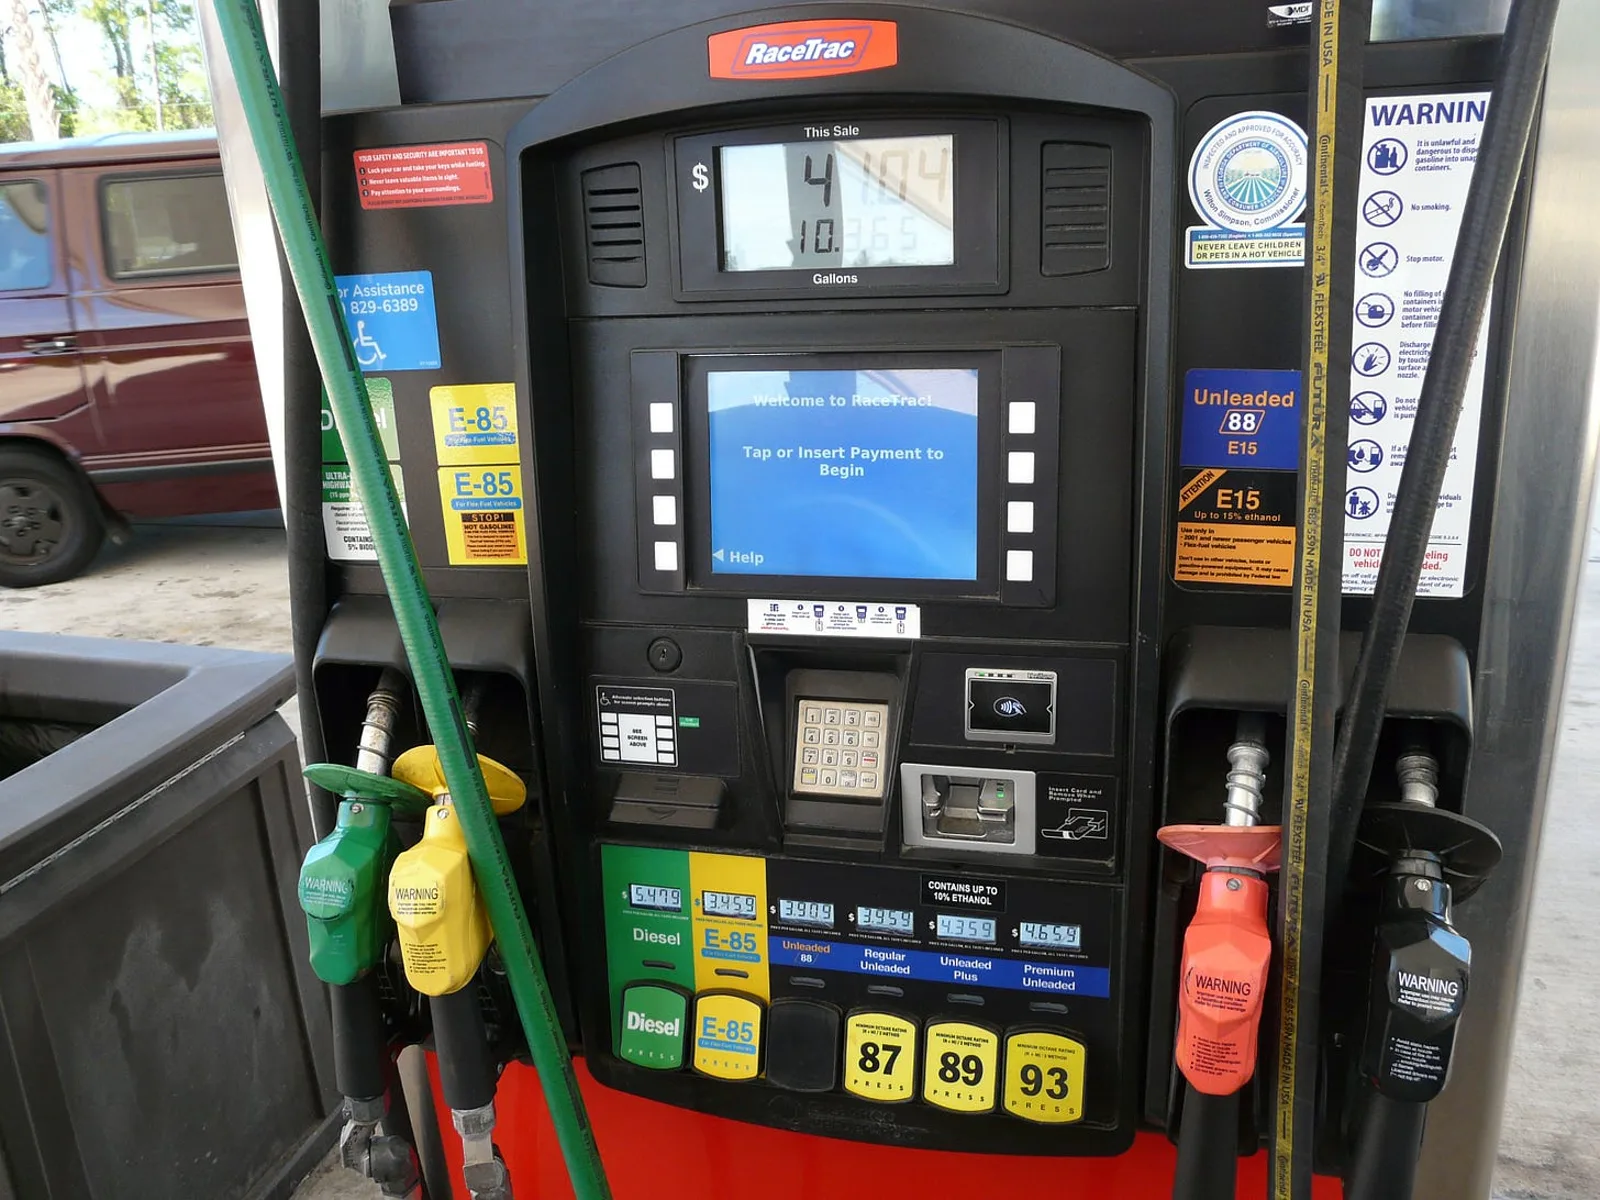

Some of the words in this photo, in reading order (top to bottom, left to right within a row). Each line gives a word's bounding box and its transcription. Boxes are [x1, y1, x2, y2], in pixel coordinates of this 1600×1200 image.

[1324, 22, 1333, 36] IN
[745, 39, 855, 65] RaceTrac
[1323, 40, 1333, 67] USA
[1371, 100, 1487, 127] WARNIN
[804, 127, 830, 138] This
[833, 126, 860, 137] Sale
[1237, 124, 1272, 135] APPROVED
[1272, 127, 1285, 138] FOR
[1431, 138, 1461, 146] unlawful
[372, 153, 392, 161] SAFETY
[403, 151, 427, 160] SECURITY
[428, 150, 438, 158] ARE
[439, 149, 468, 157] IMPORTANT
[1416, 148, 1452, 156] dangerous
[1318, 134, 1331, 188] Continental
[1415, 156, 1443, 165] gasoline
[367, 166, 380, 174] Lock
[381, 166, 392, 174] your
[402, 164, 412, 172] and
[692, 163, 709, 192] $
[371, 189, 380, 197] Pay
[1203, 189, 1218, 213] Wilton
[1254, 187, 1300, 225] Commissioner
[1421, 203, 1451, 212] smoking.
[1197, 242, 1226, 250] NEVER
[1228, 241, 1255, 250] LEAVE
[1258, 241, 1302, 249] CHILDREN
[1210, 251, 1230, 259] PETS
[1268, 250, 1302, 258] VEHICLE
[1406, 255, 1421, 263] Stop
[813, 273, 858, 285] Gallons
[353, 283, 424, 297] Assistance
[1414, 290, 1433, 298] filling
[350, 298, 418, 314] 829-6389
[1313, 292, 1326, 353] FLEXSTEEL
[1400, 341, 1431, 349] Discharge
[753, 395, 824, 408] Welcome
[830, 395, 845, 408] to
[852, 394, 932, 408] RaceTrac!
[1193, 389, 1294, 407] Unleaded
[449, 406, 508, 432] E-85
[1228, 412, 1256, 431] 88
[743, 446, 771, 462] Tap
[777, 448, 793, 459] or
[799, 447, 845, 459] Insert
[851, 447, 921, 463] Payment
[927, 448, 944, 460] to
[1228, 441, 1257, 455] E15
[820, 464, 865, 479] Begin
[454, 472, 514, 496] E-85
[1181, 470, 1215, 502] ATTENTION
[1216, 488, 1260, 510] E15
[472, 513, 504, 522] STOP!
[1194, 511, 1207, 521] Up
[1209, 512, 1219, 520] to
[1223, 512, 1242, 521] 15%
[1245, 513, 1280, 522] ethanol
[729, 552, 764, 566] Help
[1349, 548, 1361, 557] DO
[1363, 548, 1381, 557] NOT
[1304, 558, 1315, 592] MADE
[1304, 592, 1313, 606] IN
[1302, 608, 1313, 633] USA
[829, 715, 835, 723] 2
[305, 877, 348, 894] WARNING
[928, 880, 970, 893] CONTAINS
[972, 883, 984, 895] UP
[986, 886, 998, 896] TO
[395, 888, 439, 900] WARNING
[621, 890, 628, 899] $
[635, 886, 680, 905] 5.479
[934, 892, 950, 901] 10%
[952, 894, 992, 905] ETHANOL
[709, 894, 755, 912] 3.459
[770, 905, 776, 915] $
[848, 912, 855, 922] $
[928, 920, 936, 930] $
[633, 928, 680, 946] Diesel
[705, 928, 757, 952] E-85
[1011, 928, 1018, 938] $
[1025, 923, 1077, 943] 4.659
[782, 940, 831, 954] Unleaded
[801, 953, 813, 963] 88
[864, 948, 906, 962] Regular
[860, 960, 910, 975] Unleaded
[940, 956, 992, 970] Unleaded
[953, 970, 978, 982] Plus
[1024, 964, 1075, 978] Premium
[1022, 977, 1076, 991] Unleaded
[1195, 974, 1251, 996] WARNING
[1398, 971, 1459, 996] WARNING
[627, 1010, 680, 1037] Diesel
[702, 1016, 753, 1043] E-85
[858, 1041, 902, 1076] 87
[1281, 1041, 1293, 1071] MADE
[938, 1051, 984, 1086] 89
[1020, 1063, 1069, 1100] 93
[1280, 1082, 1291, 1105] USA
